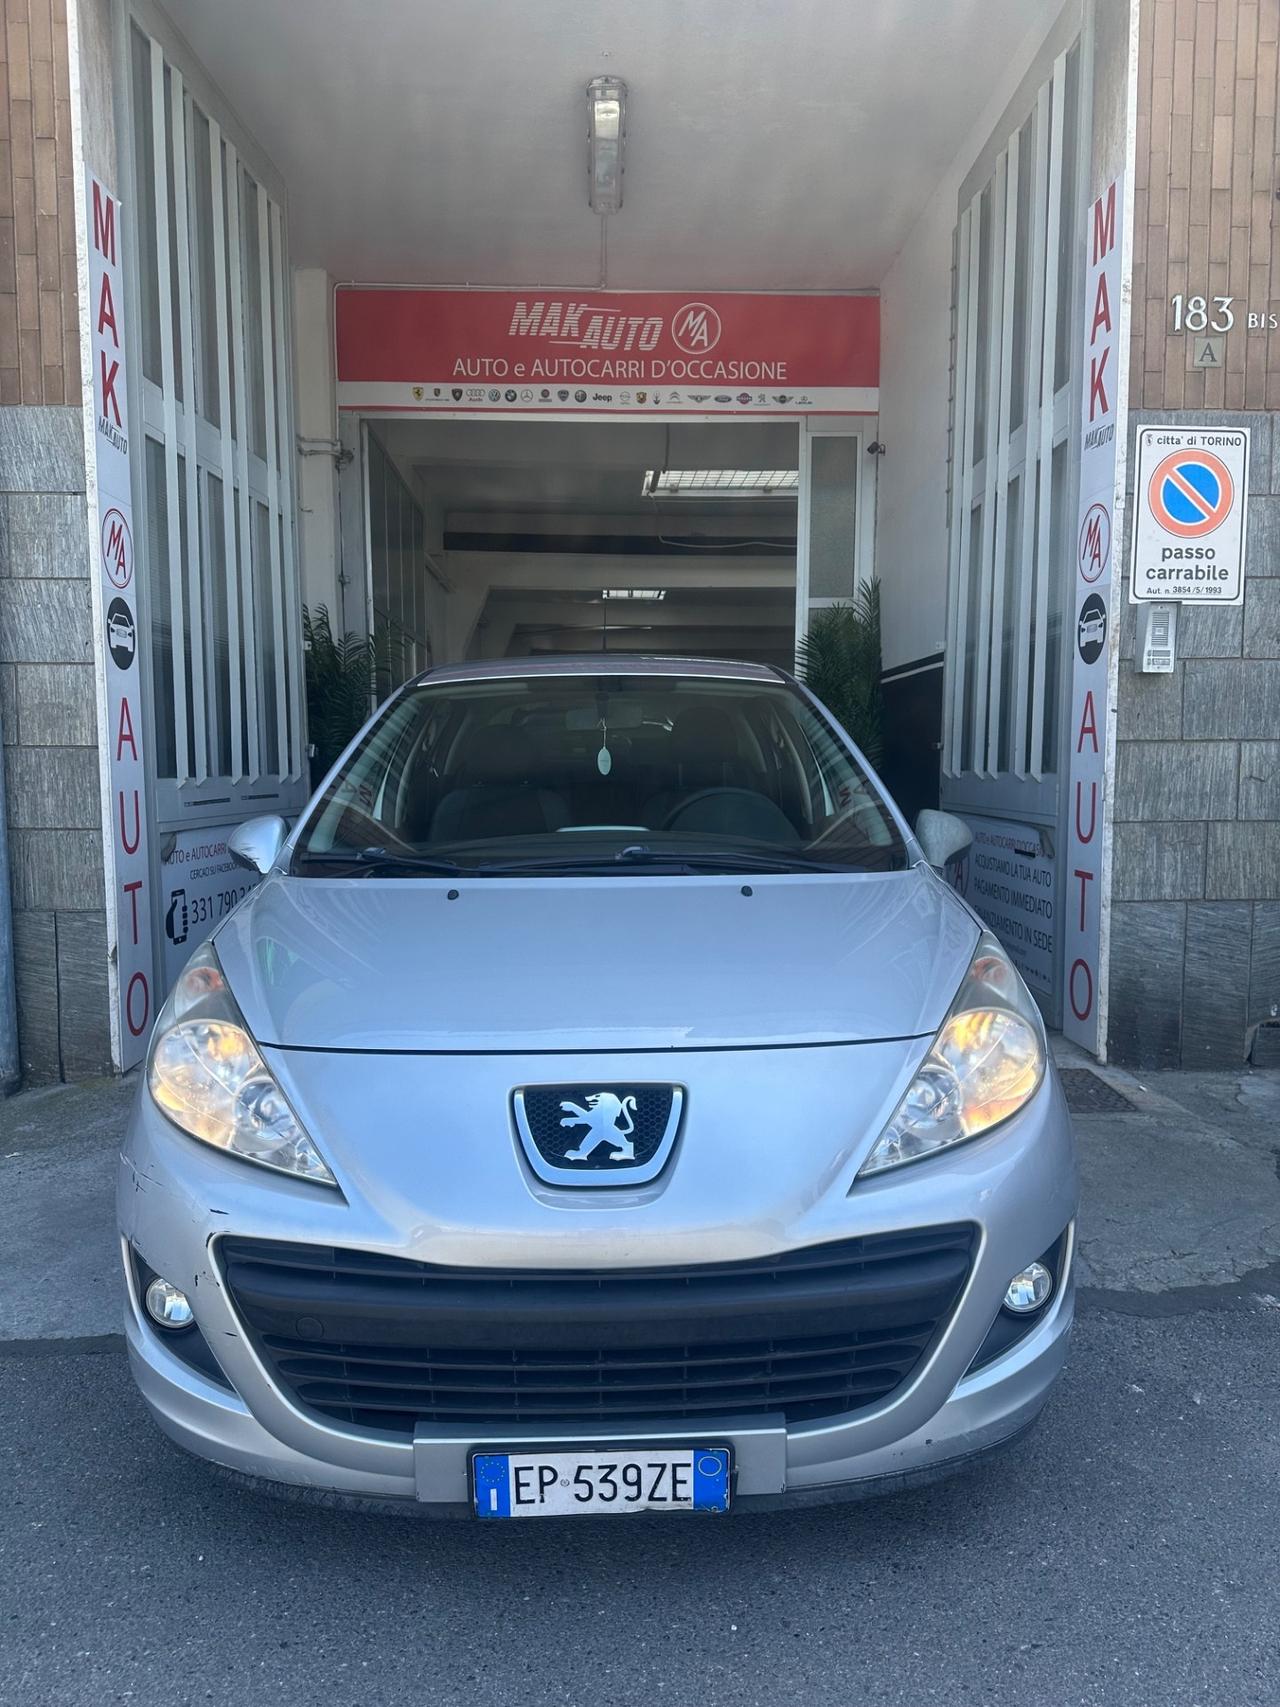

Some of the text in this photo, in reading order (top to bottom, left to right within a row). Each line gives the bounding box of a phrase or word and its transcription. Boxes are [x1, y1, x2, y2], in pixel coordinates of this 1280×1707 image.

[92, 180, 122, 428] MAK
[1090, 181, 1116, 423] MAK
[1171, 294, 1278, 332] 183 BIS
[508, 302, 664, 351] MAK AUTO
[678, 311, 708, 347] MA
[452, 358, 788, 380] AUTO e AUTOCARRI D'OCCASIONE
[1199, 342, 1217, 362] A
[592, 393, 613, 403] Jeep
[1157, 436, 1242, 446] citta' di TORINO
[106, 520, 127, 579] MA
[1082, 514, 1101, 572] MA
[1162, 547, 1216, 562] passo
[1146, 565, 1229, 580] carrabile
[116, 697, 150, 1037] AUTO
[191, 843, 227, 861] AUTOCARRI
[1069, 690, 1100, 1022] AUTO
[1033, 867, 1052, 887] AUTO
[192, 896, 213, 924] 331
[974, 877, 1053, 919] PAGAMENTO IMMEDIATO
[1033, 929, 1053, 953] SEDE
[514, 1462, 692, 1505] EP 539ZE
